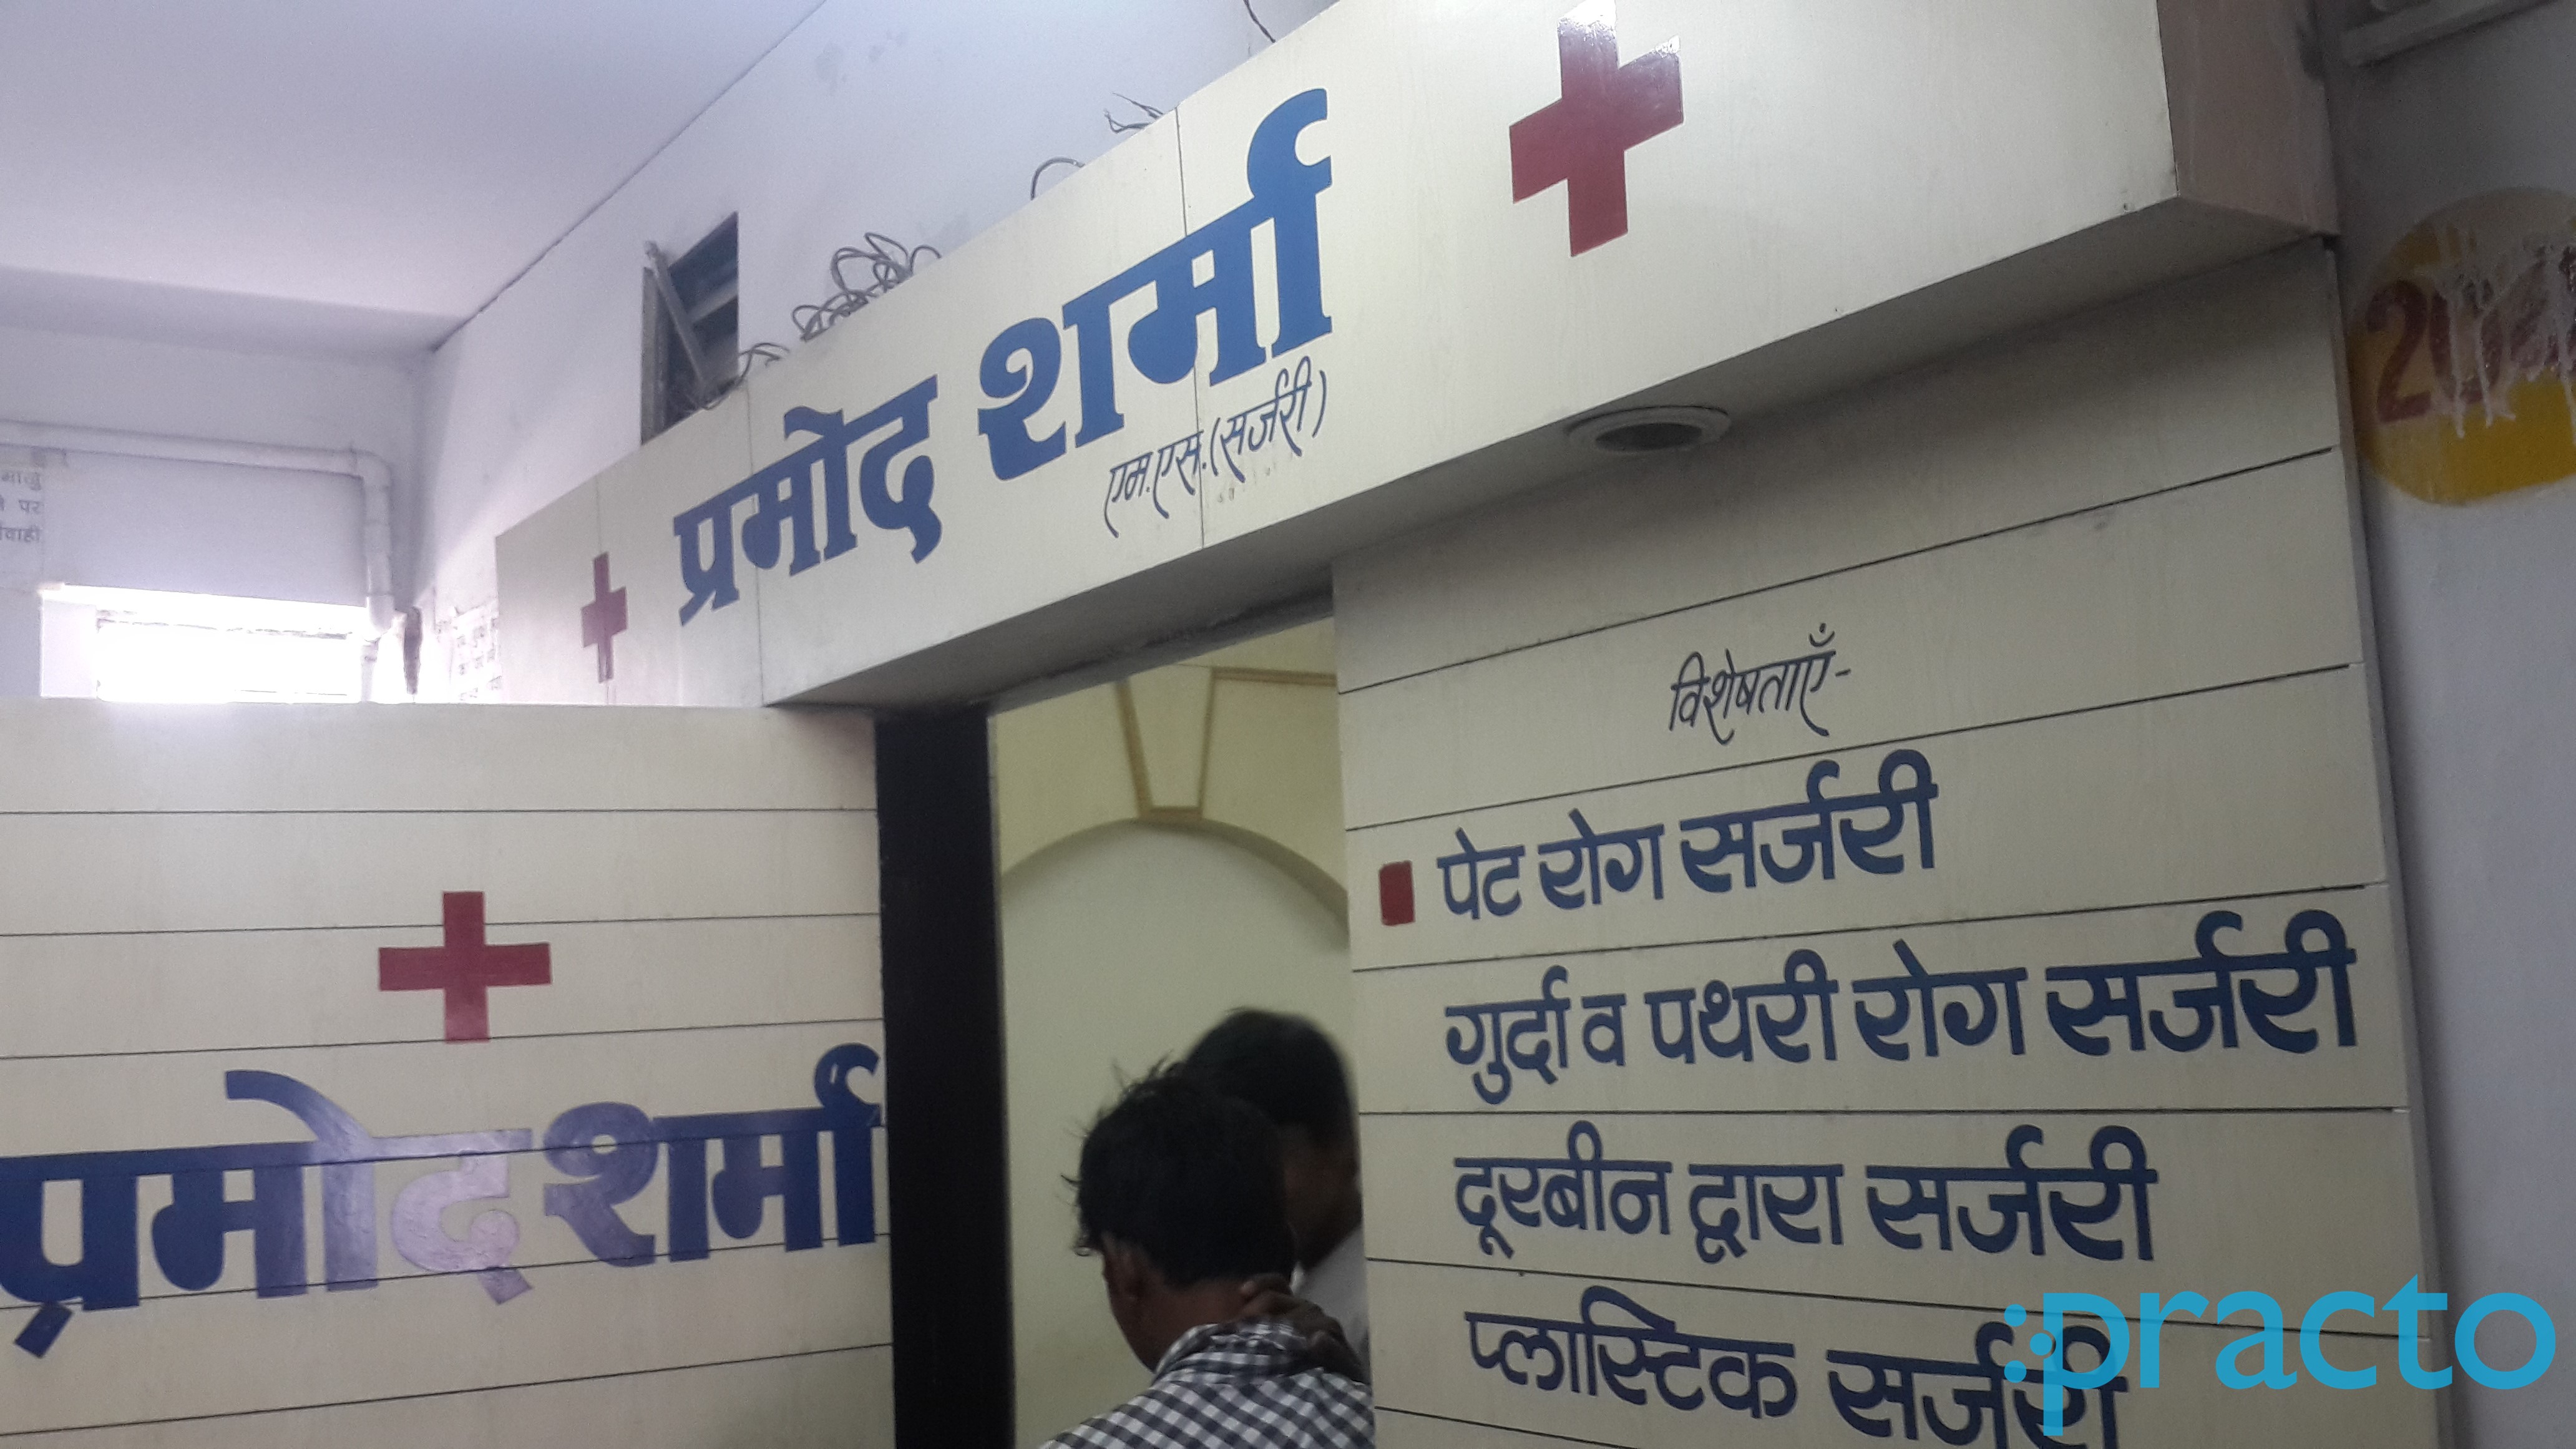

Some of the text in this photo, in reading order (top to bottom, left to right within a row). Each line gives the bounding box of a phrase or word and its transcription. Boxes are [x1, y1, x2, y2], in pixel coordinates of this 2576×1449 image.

[673, 87, 1334, 626] प्रमोद शर्मा
[1437, 749, 1939, 920] पेट रोग सर्जरी
[1445, 909, 2357, 1105] गुर्दा व पथरी रोग सर्जरी
[0, 1042, 882, 1359] प्रमोद शर्मा
[1454, 1120, 2159, 1265] दूरबीन द्वारा सर्जरी
[1464, 1285, 2130, 1449] प्लास्टिक सर्जरी
